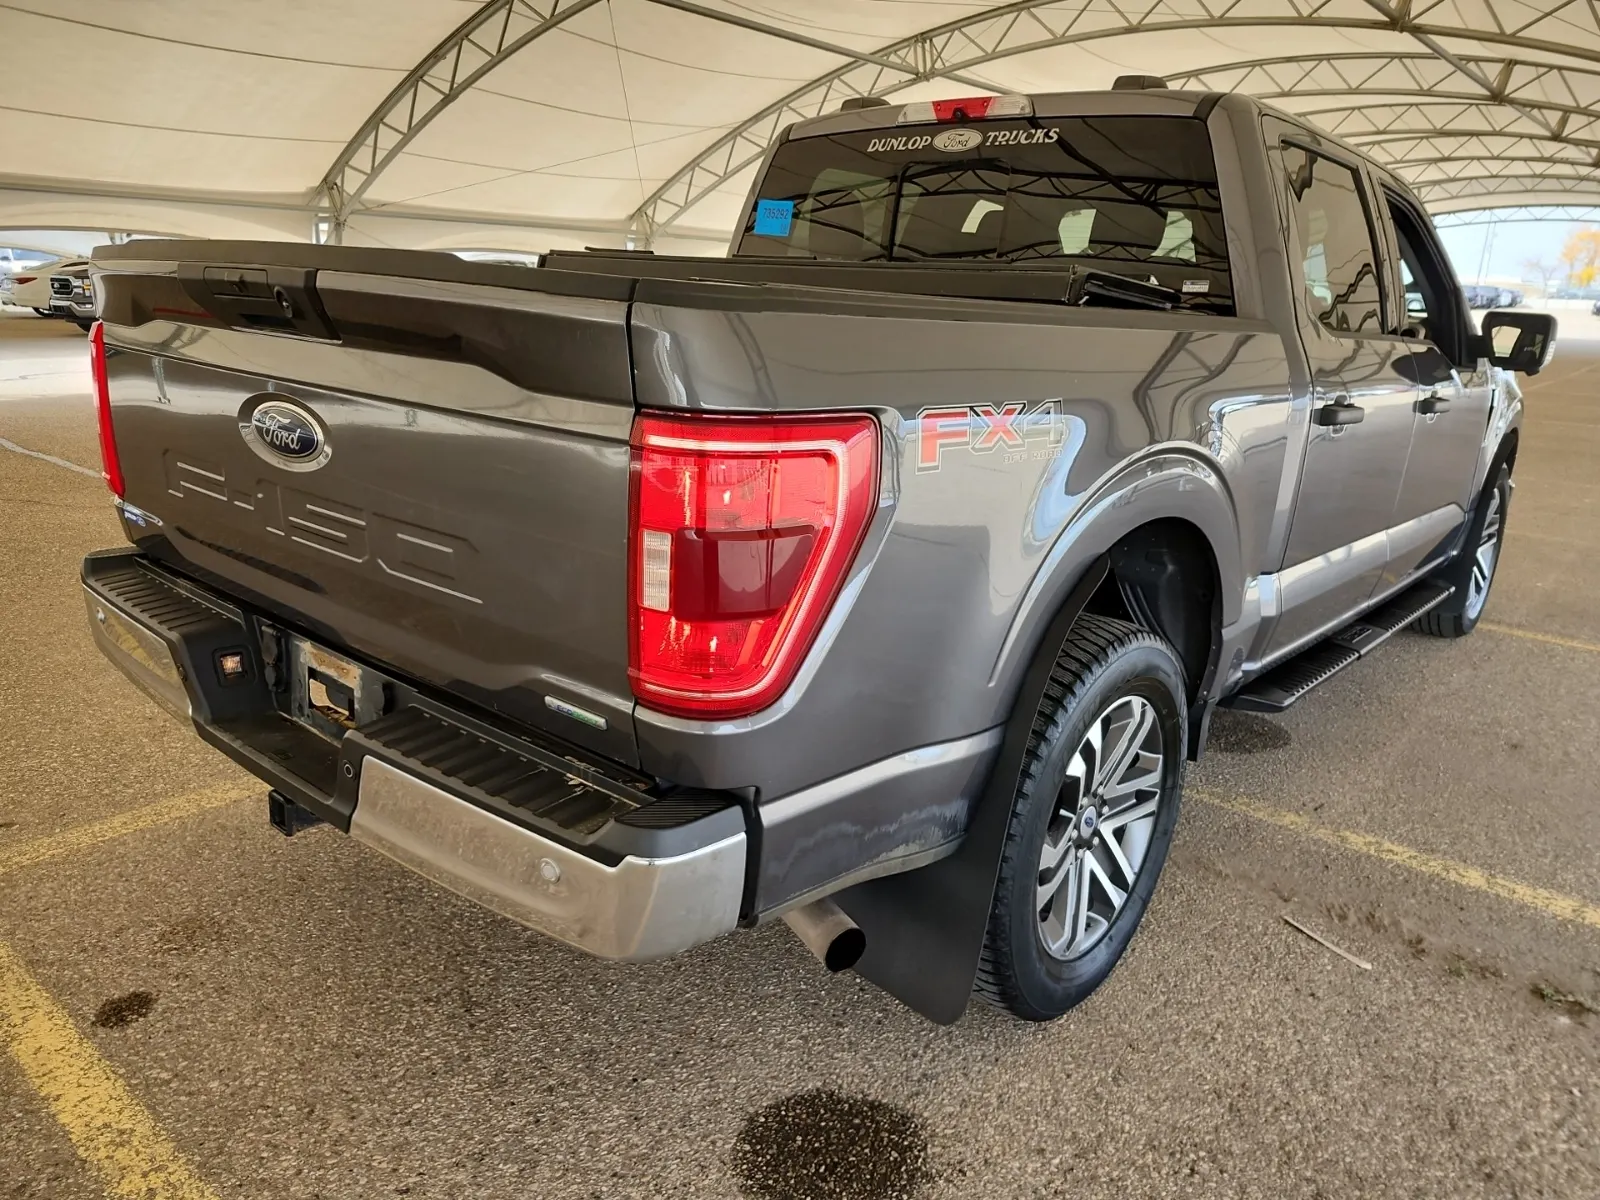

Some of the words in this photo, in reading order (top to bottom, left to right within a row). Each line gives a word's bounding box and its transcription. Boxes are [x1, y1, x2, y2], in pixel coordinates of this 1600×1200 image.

[867, 136, 932, 152] DUNLOP
[943, 132, 971, 149] Ford
[985, 127, 1060, 146] TRUCKS
[263, 413, 301, 450] Ford
[916, 398, 1065, 475] FX4
[162, 448, 483, 604] F-150
